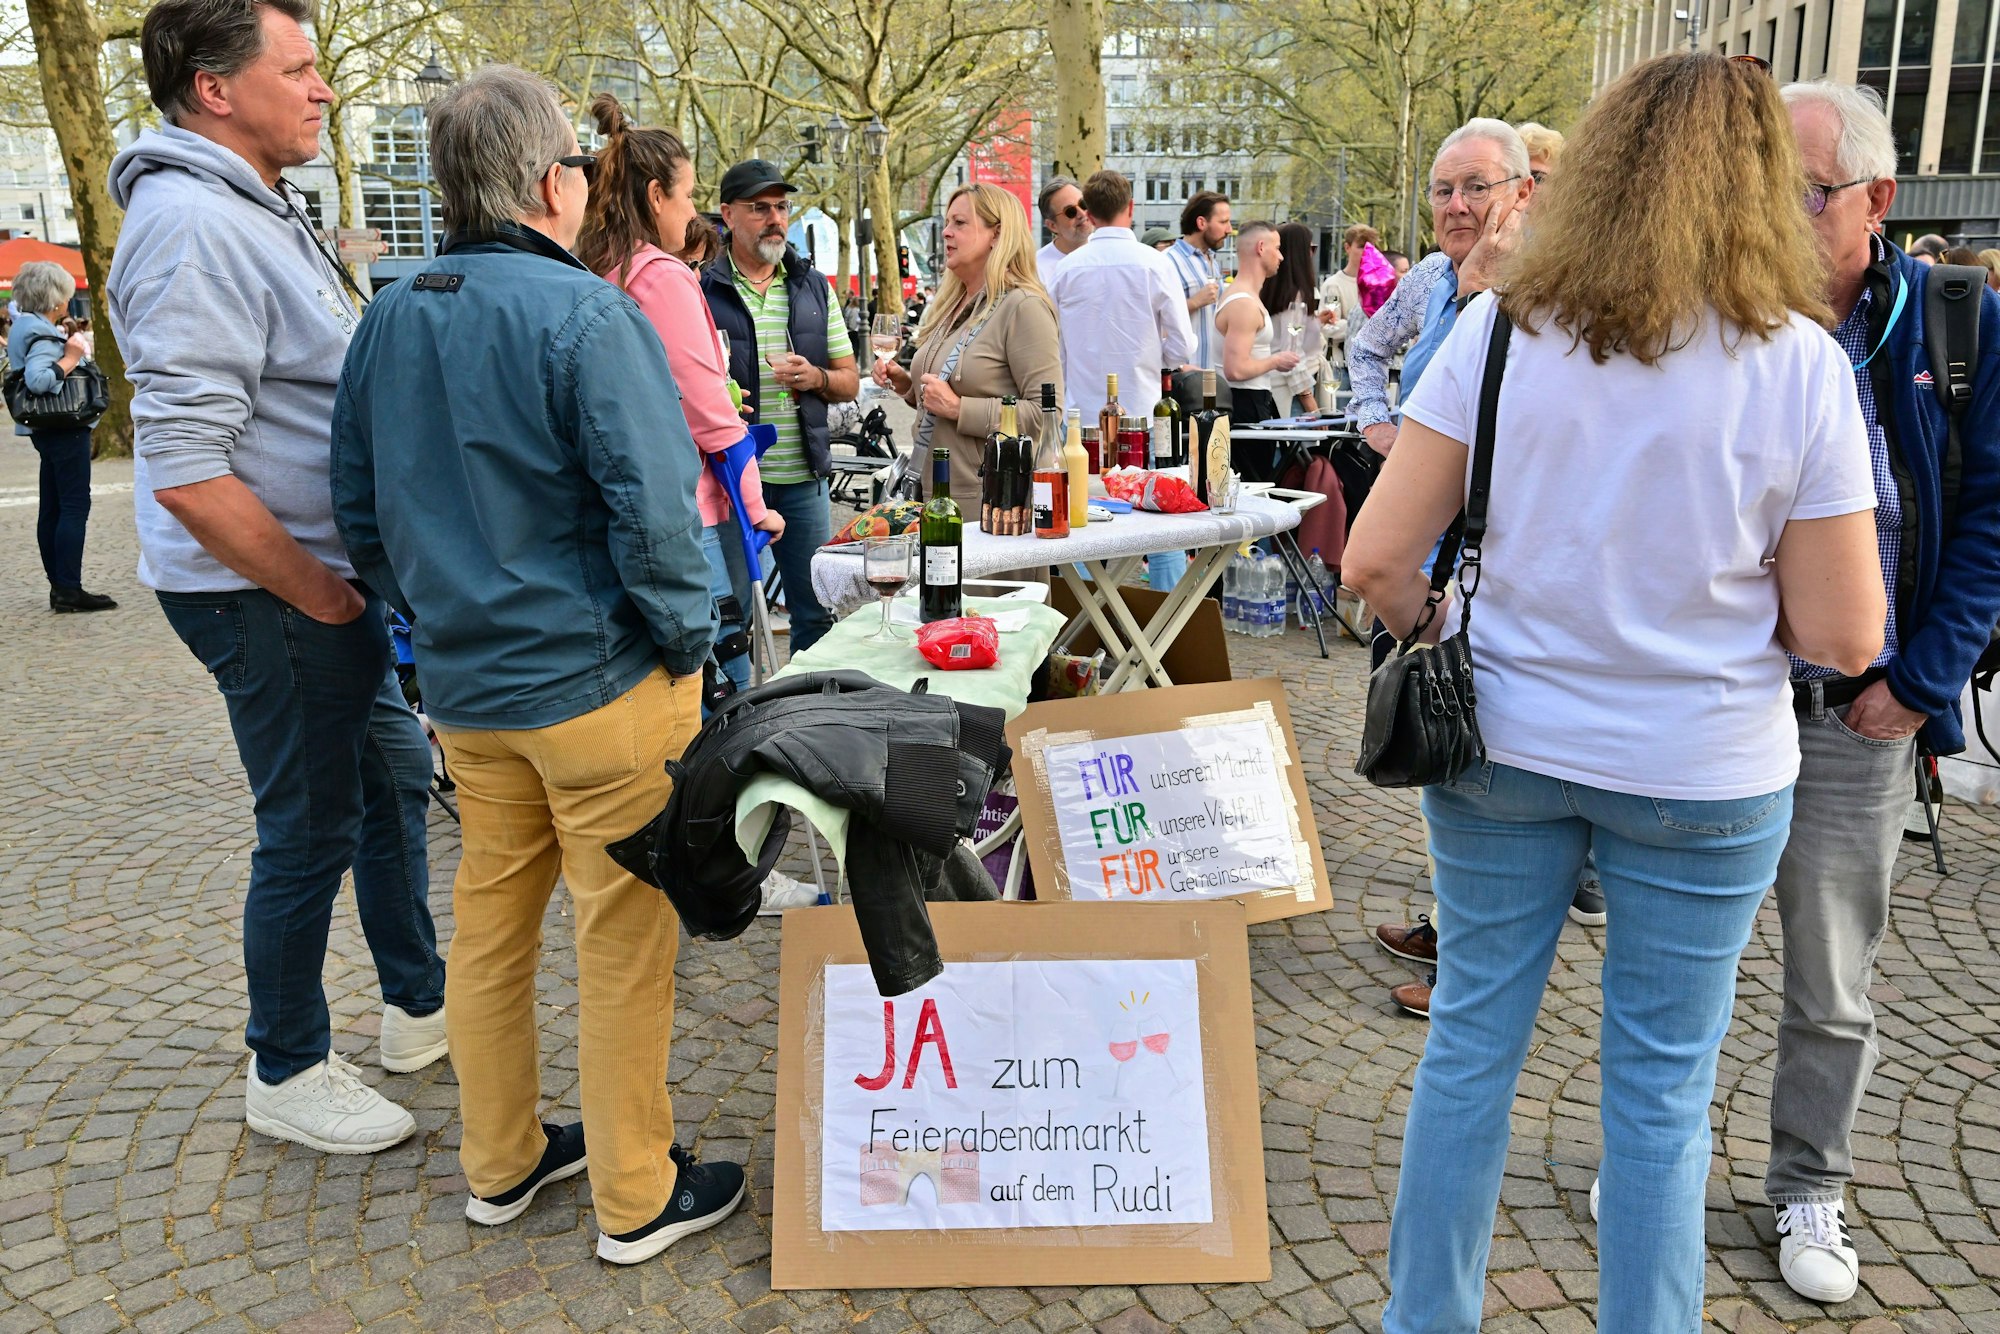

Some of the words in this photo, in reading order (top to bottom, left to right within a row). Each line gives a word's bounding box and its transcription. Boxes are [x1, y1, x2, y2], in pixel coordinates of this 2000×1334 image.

[1078, 752, 1141, 800] FÜR
[1150, 762, 1214, 790] unseren
[1214, 747, 1268, 780] Markt
[1090, 802, 1155, 849] FÜR
[1159, 814, 1206, 836] unsere
[1203, 793, 1270, 826] Vielfalt
[1100, 849, 1166, 898] FÜR
[1167, 845, 1219, 865] unsere
[1169, 855, 1279, 893] Gemeinschaft
[854, 998, 958, 1091] JA
[991, 1057, 1081, 1090] zum
[867, 1108, 1151, 1155] Feierabendmarkt
[990, 1174, 1027, 1202] auf
[1032, 1174, 1075, 1201] dem
[1092, 1164, 1173, 1213] Rudi
